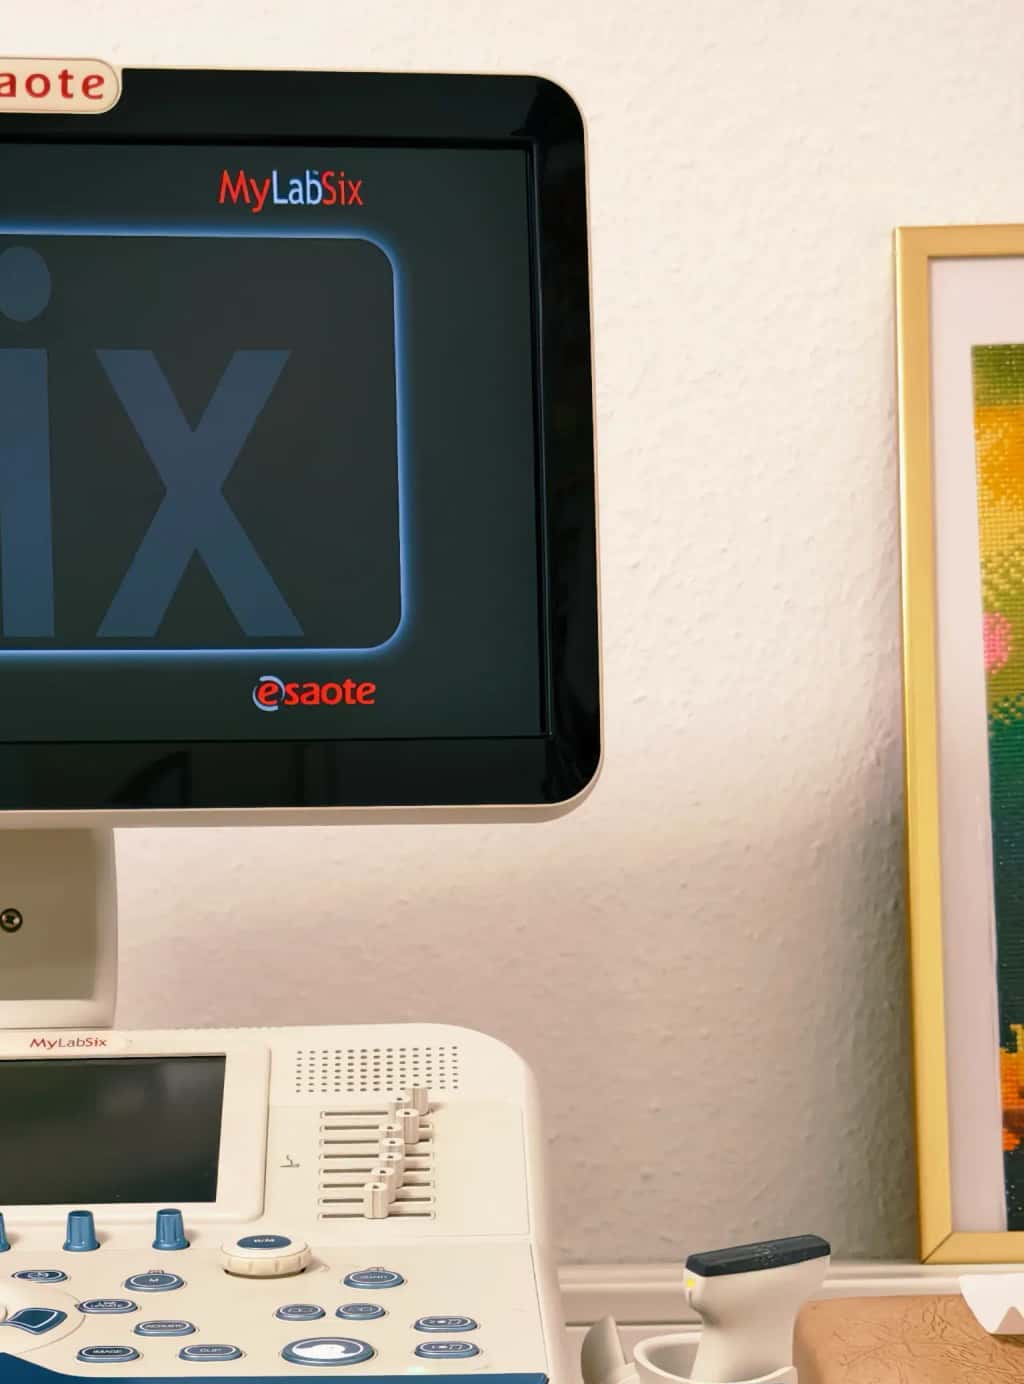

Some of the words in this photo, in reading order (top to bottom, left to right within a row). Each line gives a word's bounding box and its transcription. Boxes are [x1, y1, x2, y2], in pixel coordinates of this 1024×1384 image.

[219, 169, 364, 213] MyLabSix
[252, 675, 377, 712] esaote
[29, 1036, 108, 1050] MyLabSix
